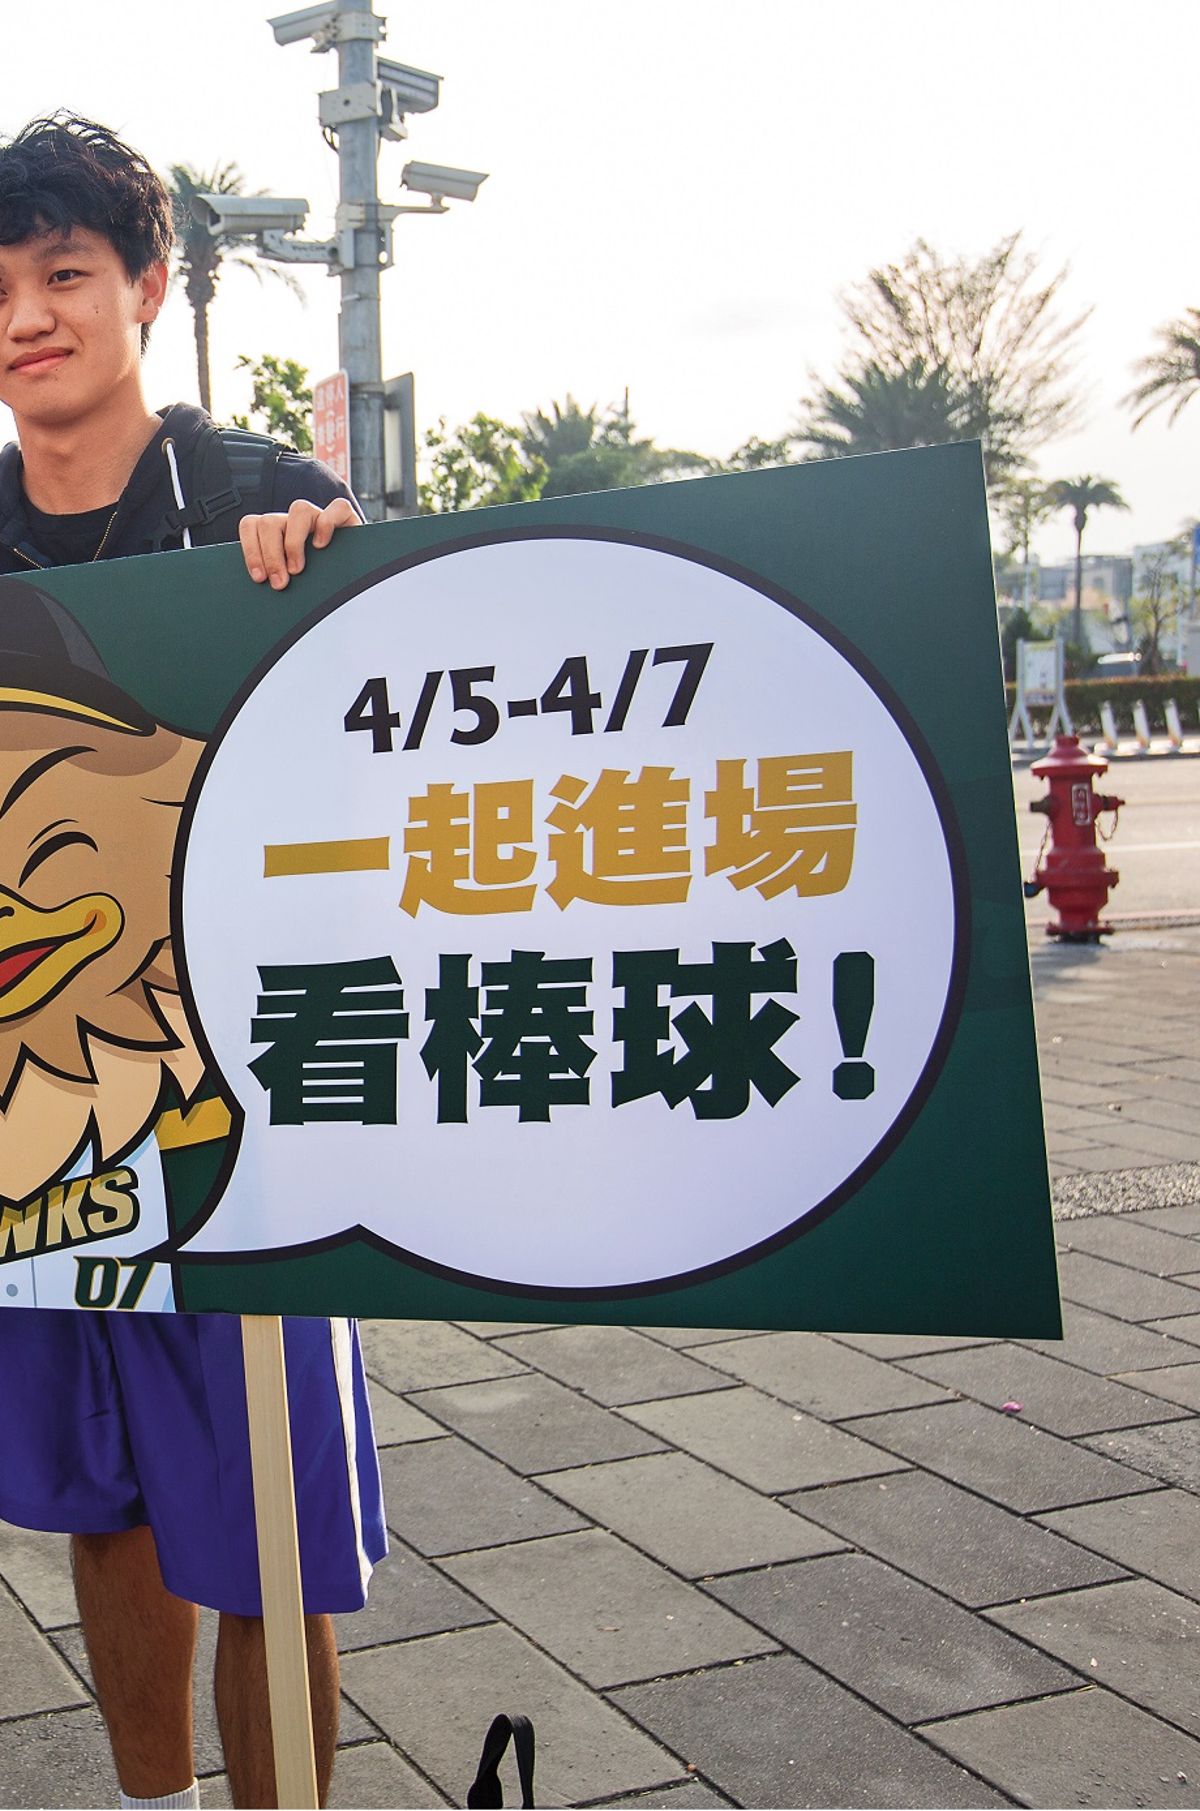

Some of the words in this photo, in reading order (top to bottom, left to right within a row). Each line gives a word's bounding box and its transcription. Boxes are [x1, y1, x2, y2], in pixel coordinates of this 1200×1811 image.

[343, 642, 715, 754] 4/5-4/7
[262, 750, 858, 919] 一起進場
[246, 937, 875, 1127] 看棒球！
[73, 1256, 156, 1310] 07
